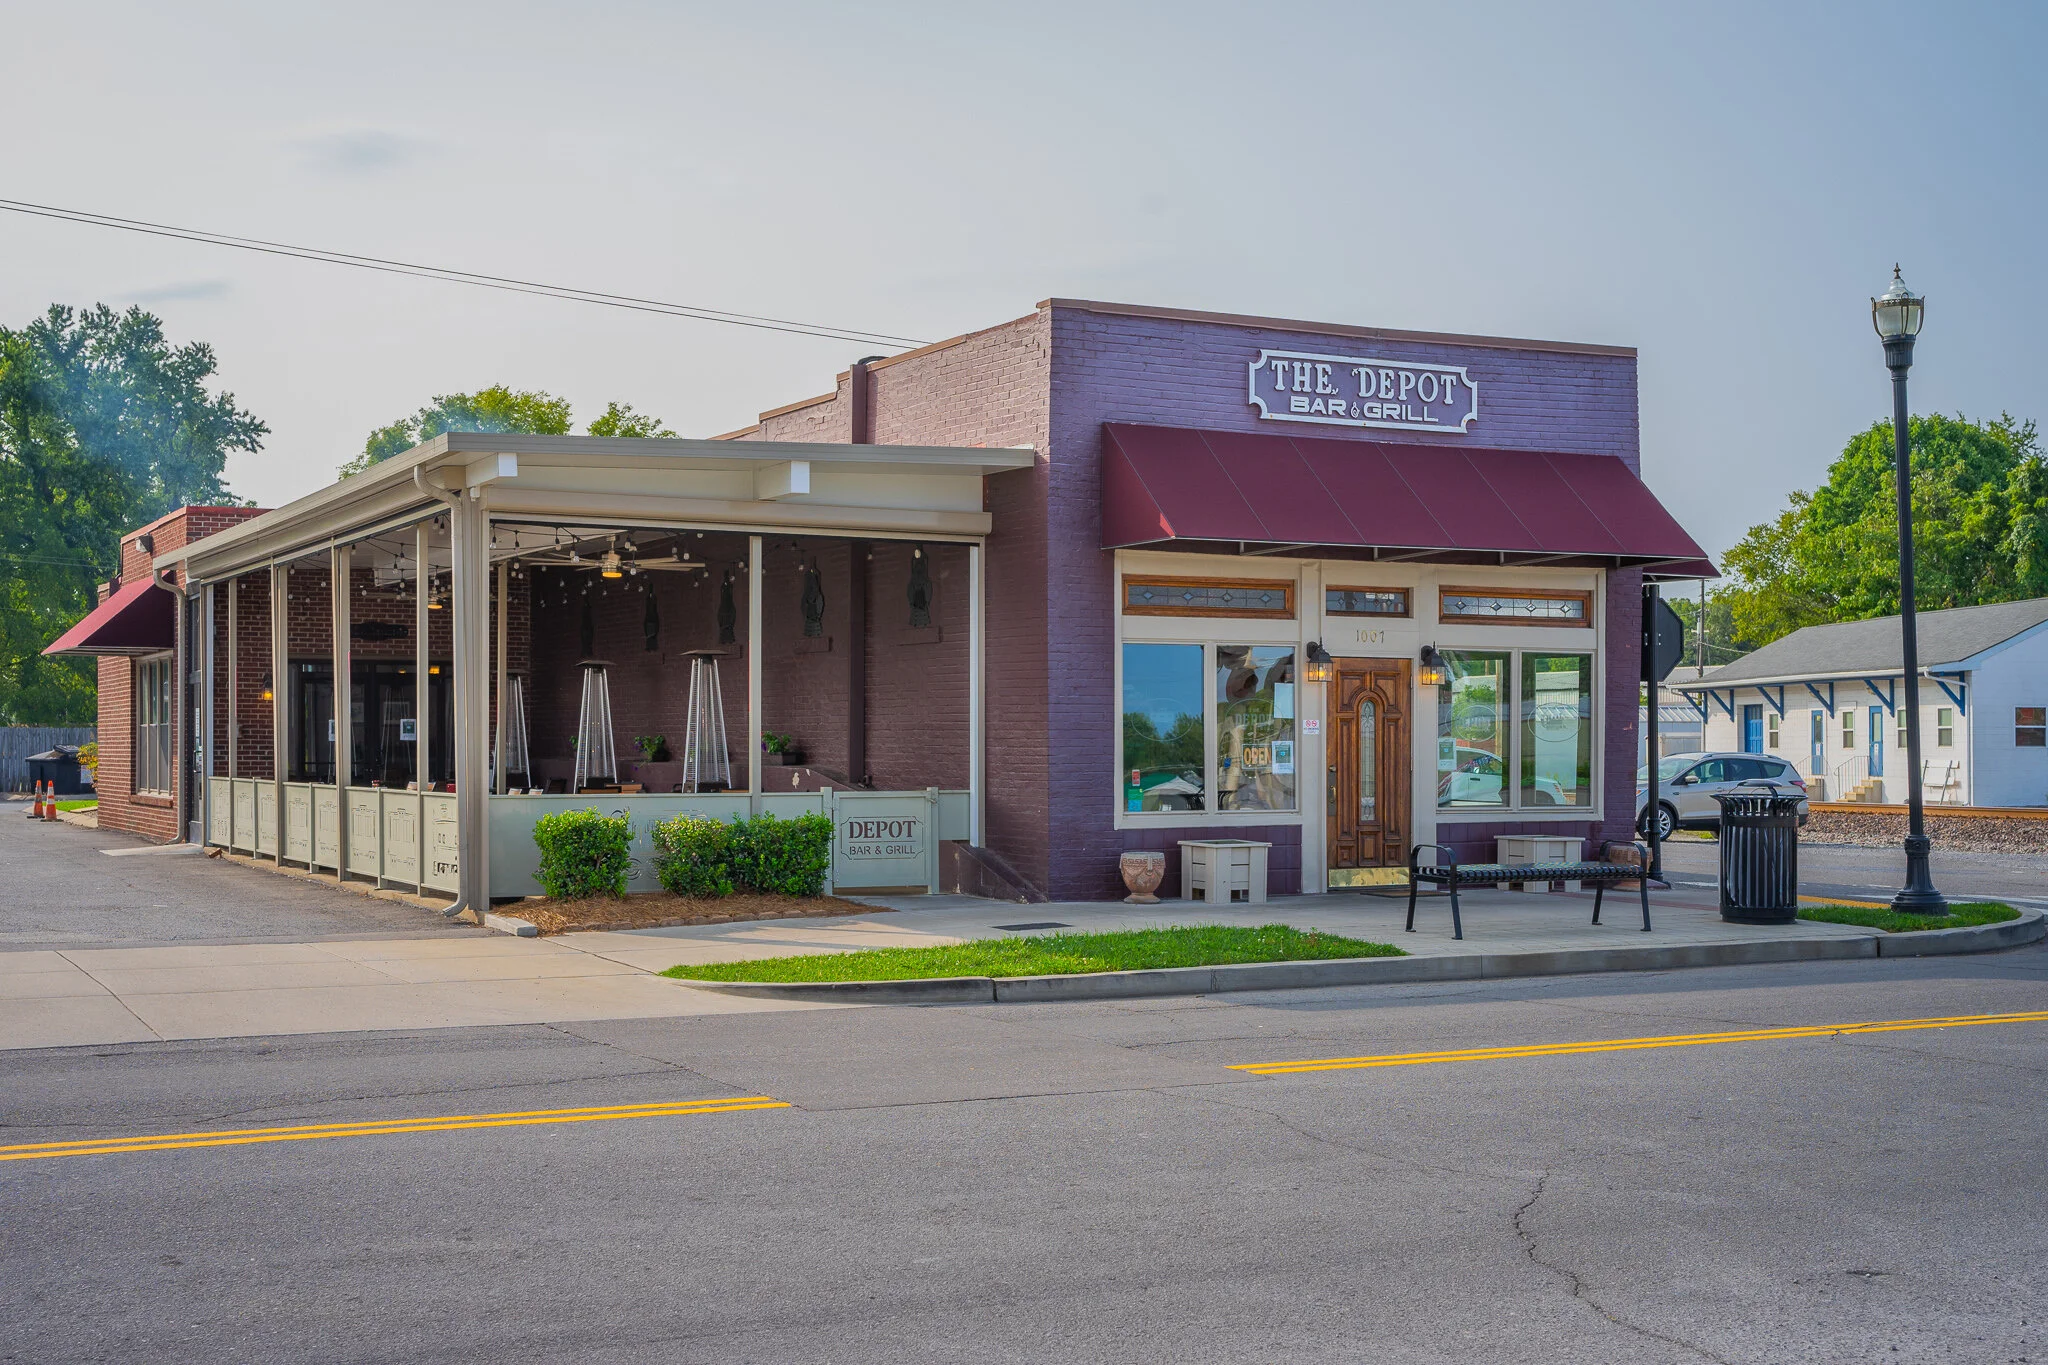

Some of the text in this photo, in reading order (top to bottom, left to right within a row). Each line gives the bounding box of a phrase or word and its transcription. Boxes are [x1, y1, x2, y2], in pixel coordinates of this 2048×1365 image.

[1271, 360, 1457, 405] THE DEPOT
[1290, 395, 1347, 416] BAR
[1363, 402, 1439, 422] GRILL
[1356, 629, 1385, 644] 1007
[1243, 746, 1272, 765] OPEN
[848, 820, 917, 839] DEPOT
[849, 844, 916, 856] BAR & GRILL
